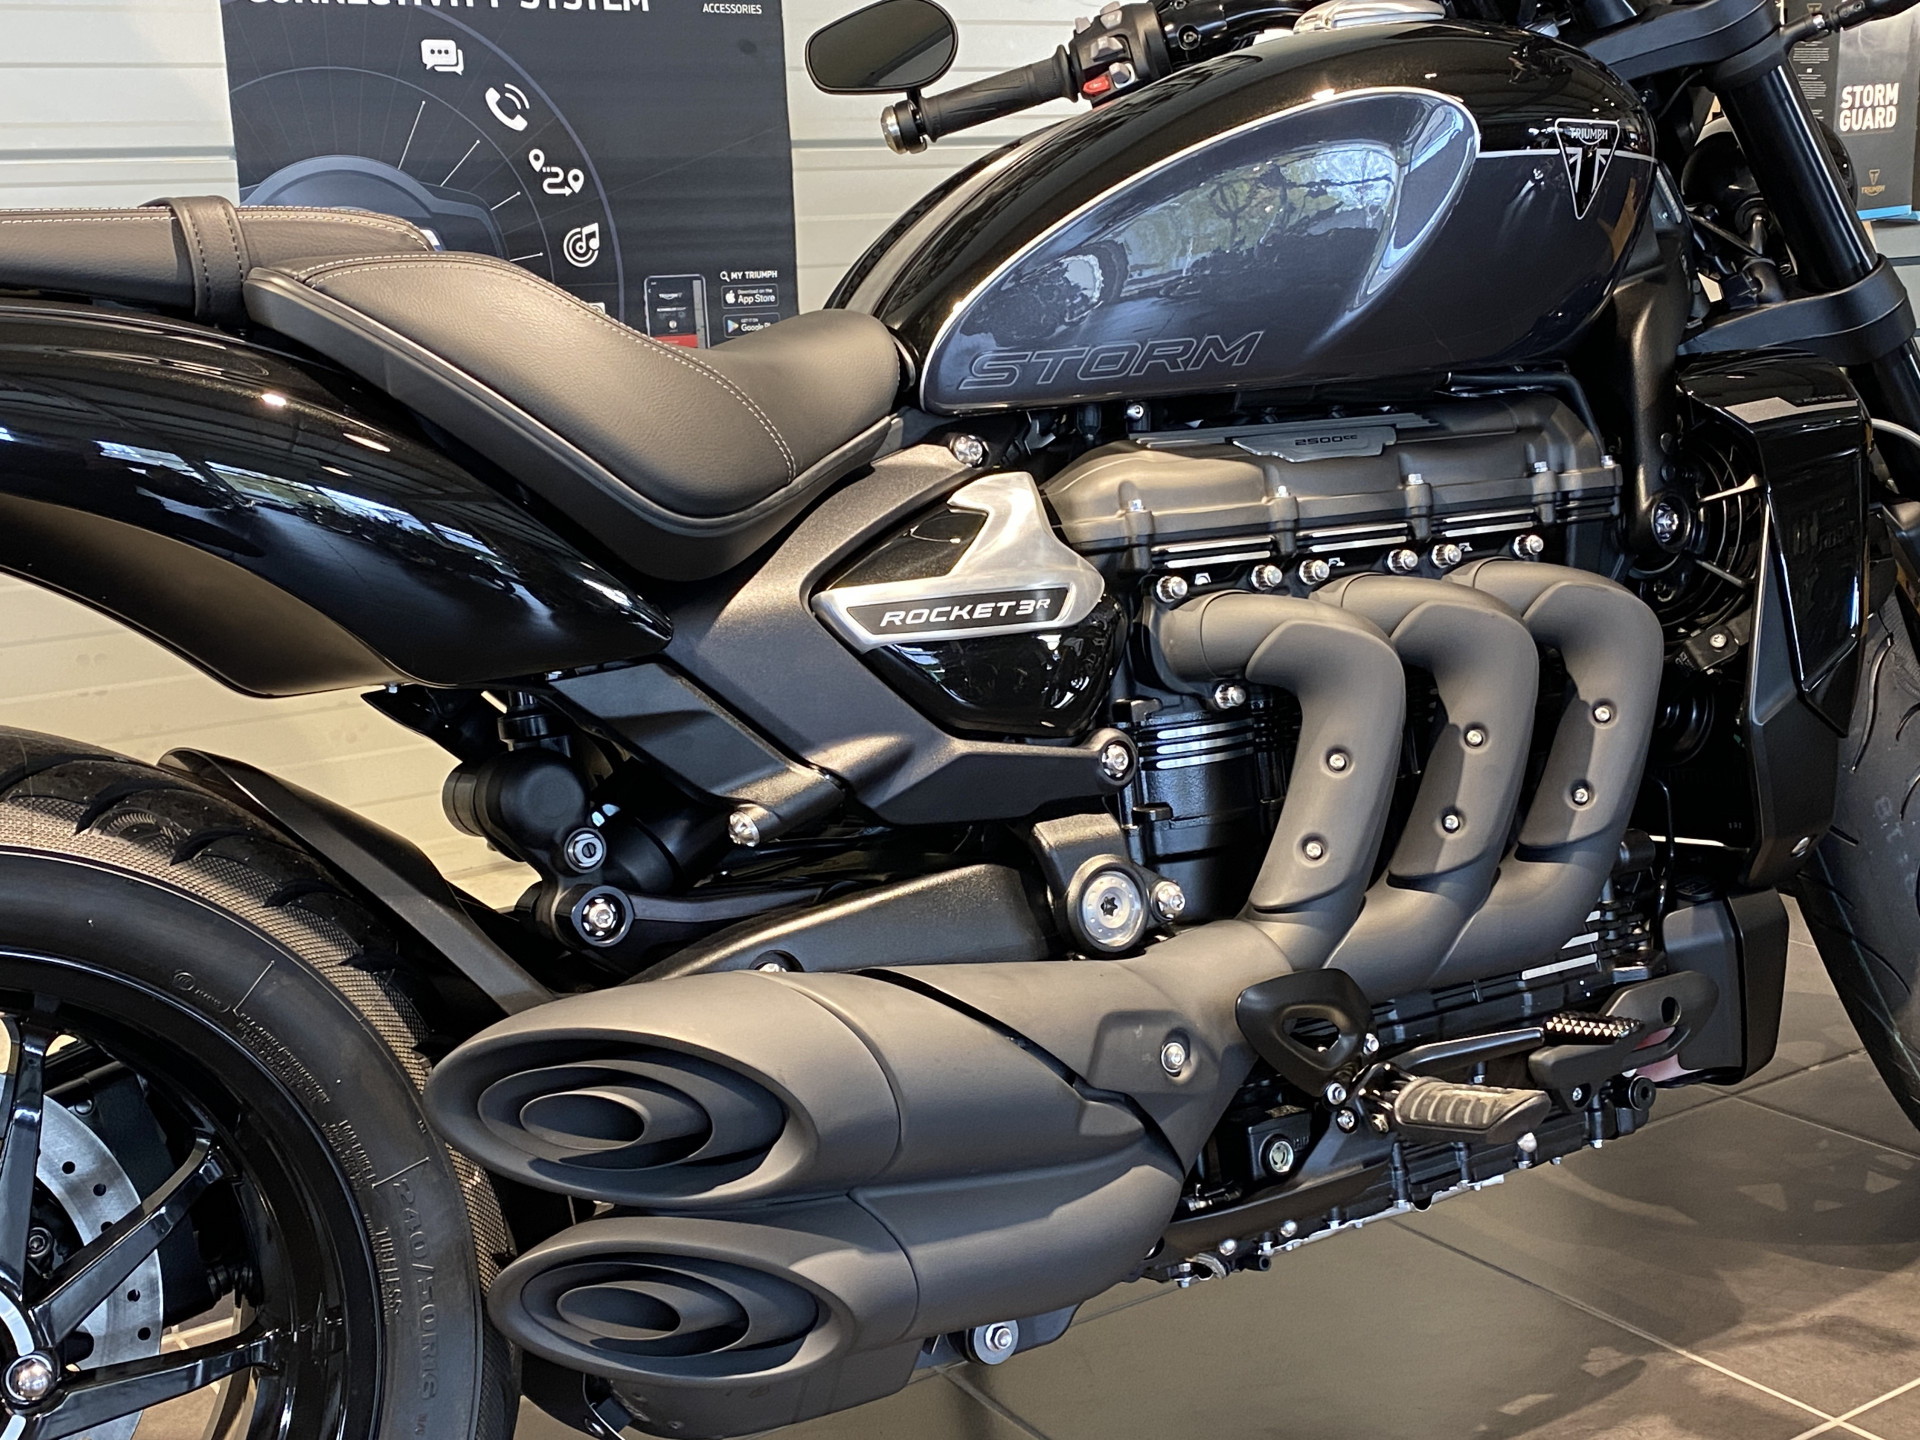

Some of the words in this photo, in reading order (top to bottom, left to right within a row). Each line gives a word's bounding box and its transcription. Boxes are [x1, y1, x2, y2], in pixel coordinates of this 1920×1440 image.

[703, 3, 762, 14] ACCESSORIES
[1841, 83, 1899, 108] STORM
[1839, 106, 1897, 131] GUARD
[1570, 128, 1608, 140] TRIUMPH
[731, 272, 743, 280] MY
[745, 270, 778, 279] TRIUMPH
[737, 294, 754, 305] App
[754, 293, 776, 303] Store
[741, 323, 764, 332] Google
[959, 331, 1264, 390] STORM
